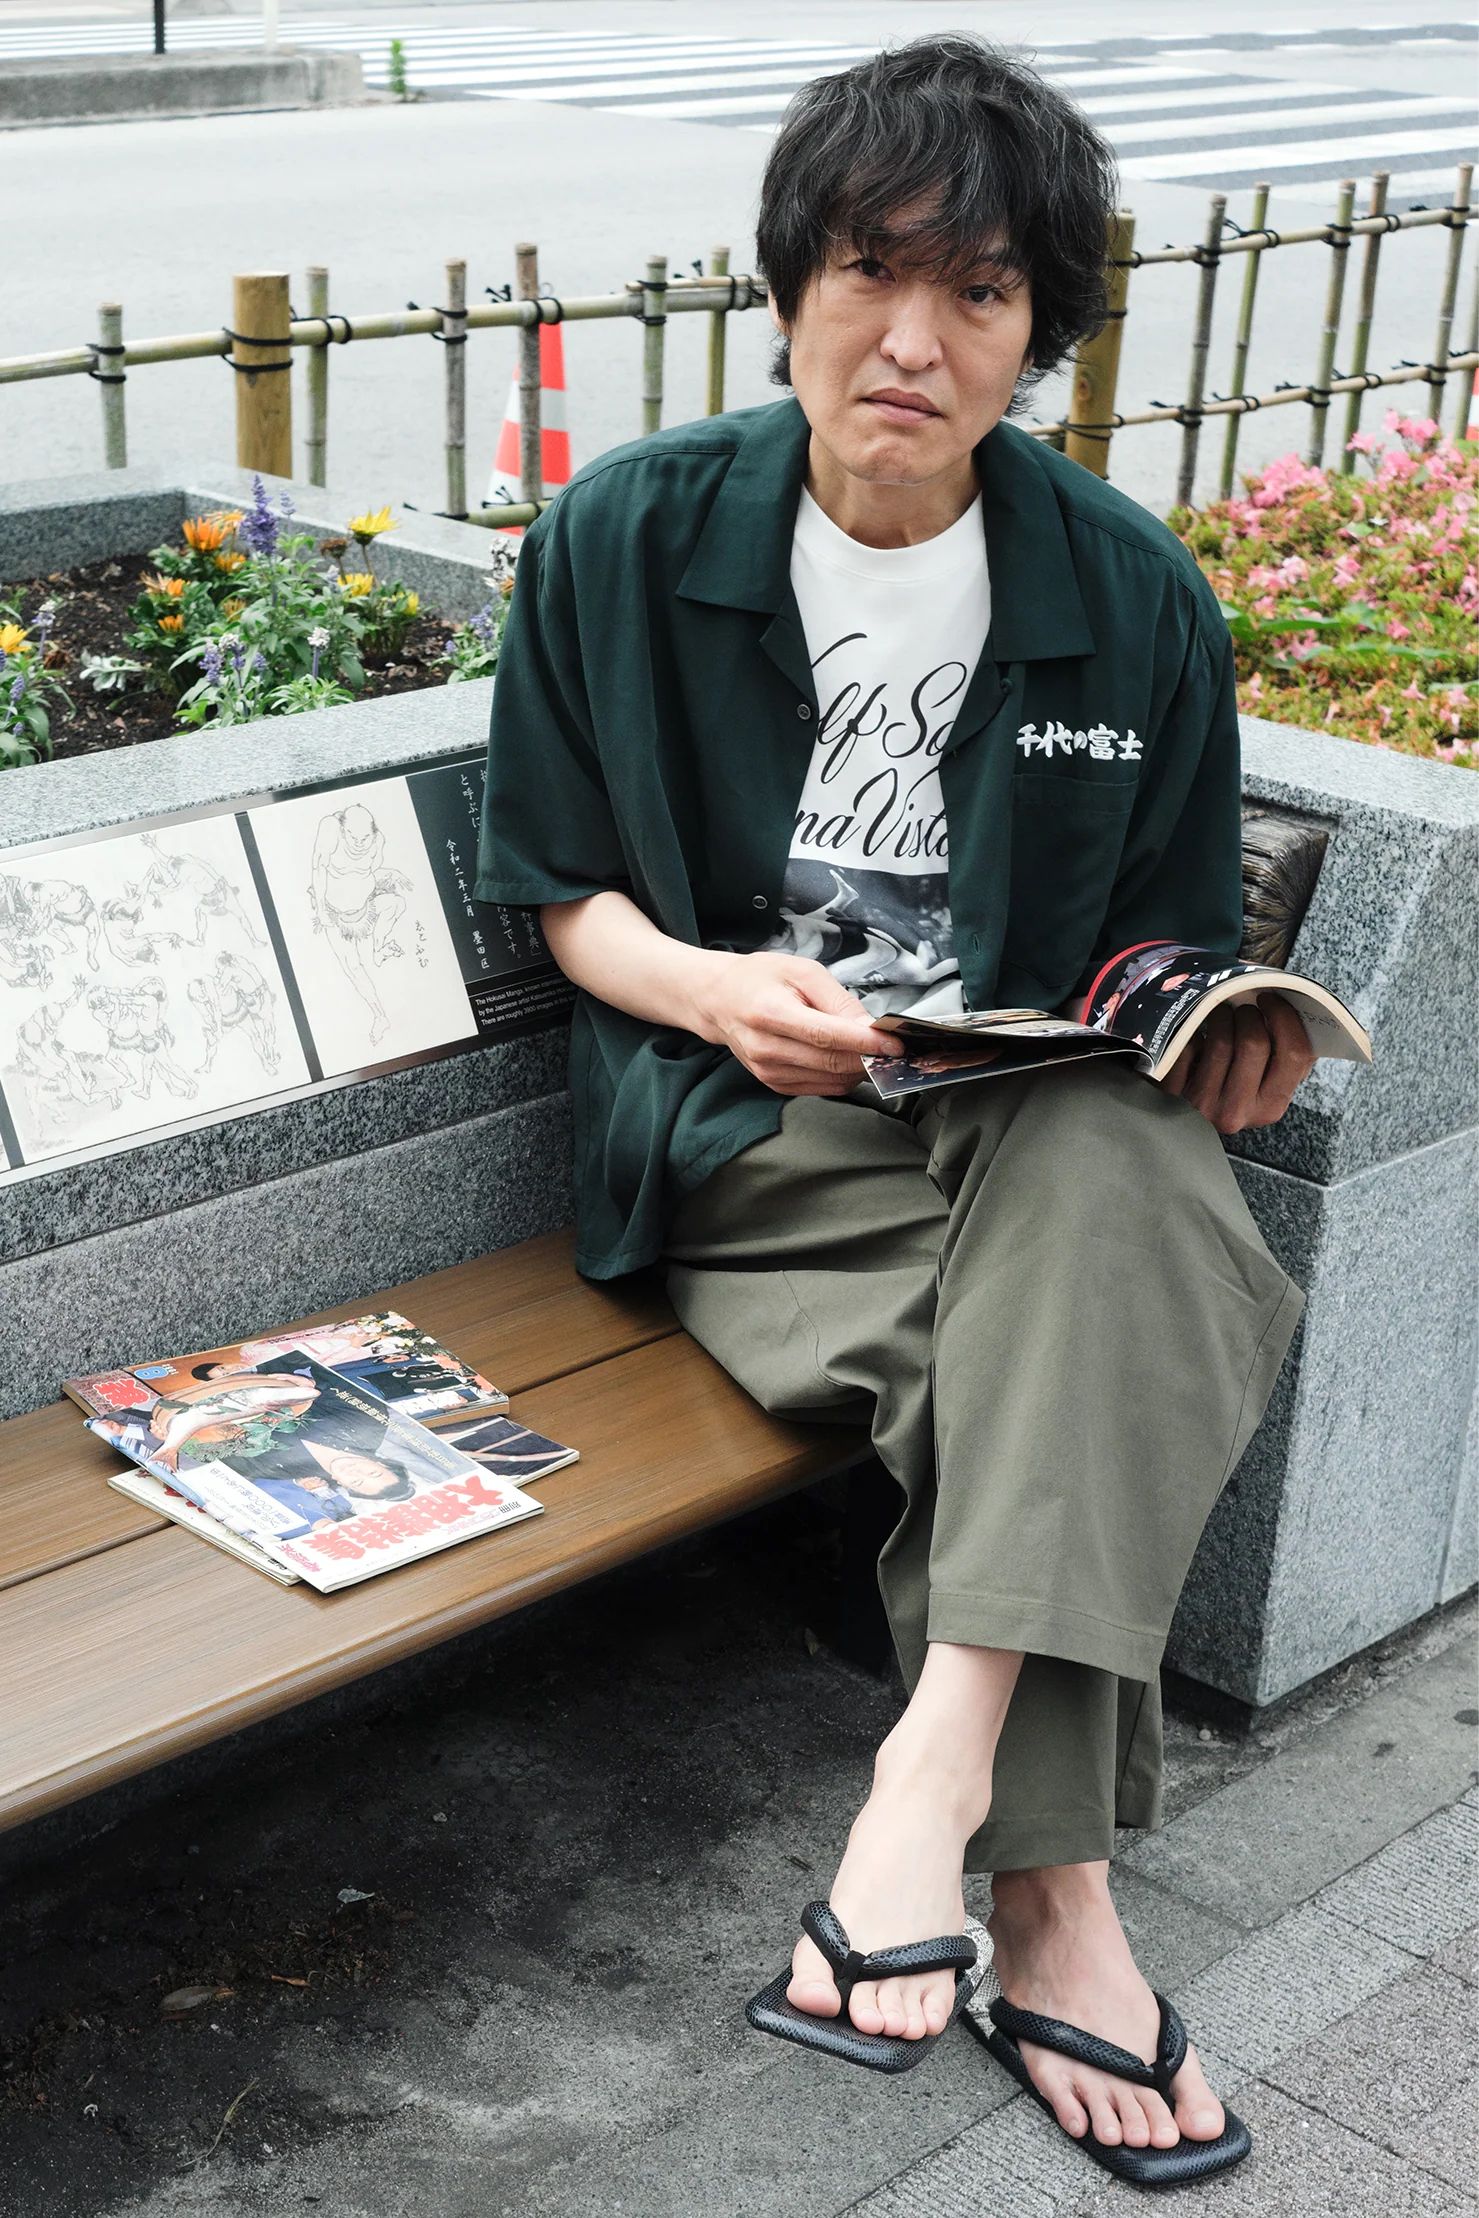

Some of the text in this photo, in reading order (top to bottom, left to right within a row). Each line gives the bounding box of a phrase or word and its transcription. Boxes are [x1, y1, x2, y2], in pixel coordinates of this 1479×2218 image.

[882, 661, 967, 758] So
[1016, 720, 1144, 760] 千代の富士
[460, 774, 481, 831] と呼ぶに
[795, 809, 861, 849] na
[445, 838, 490, 969] 令和二年三月 墨田区
[481, 1017, 496, 1026] There
[505, 1010, 523, 1019] roughly
[485, 993, 506, 1003] Hokusai
[494, 1001, 518, 1012] Japanese
[302, 1475, 504, 1560] 大相撲特集
